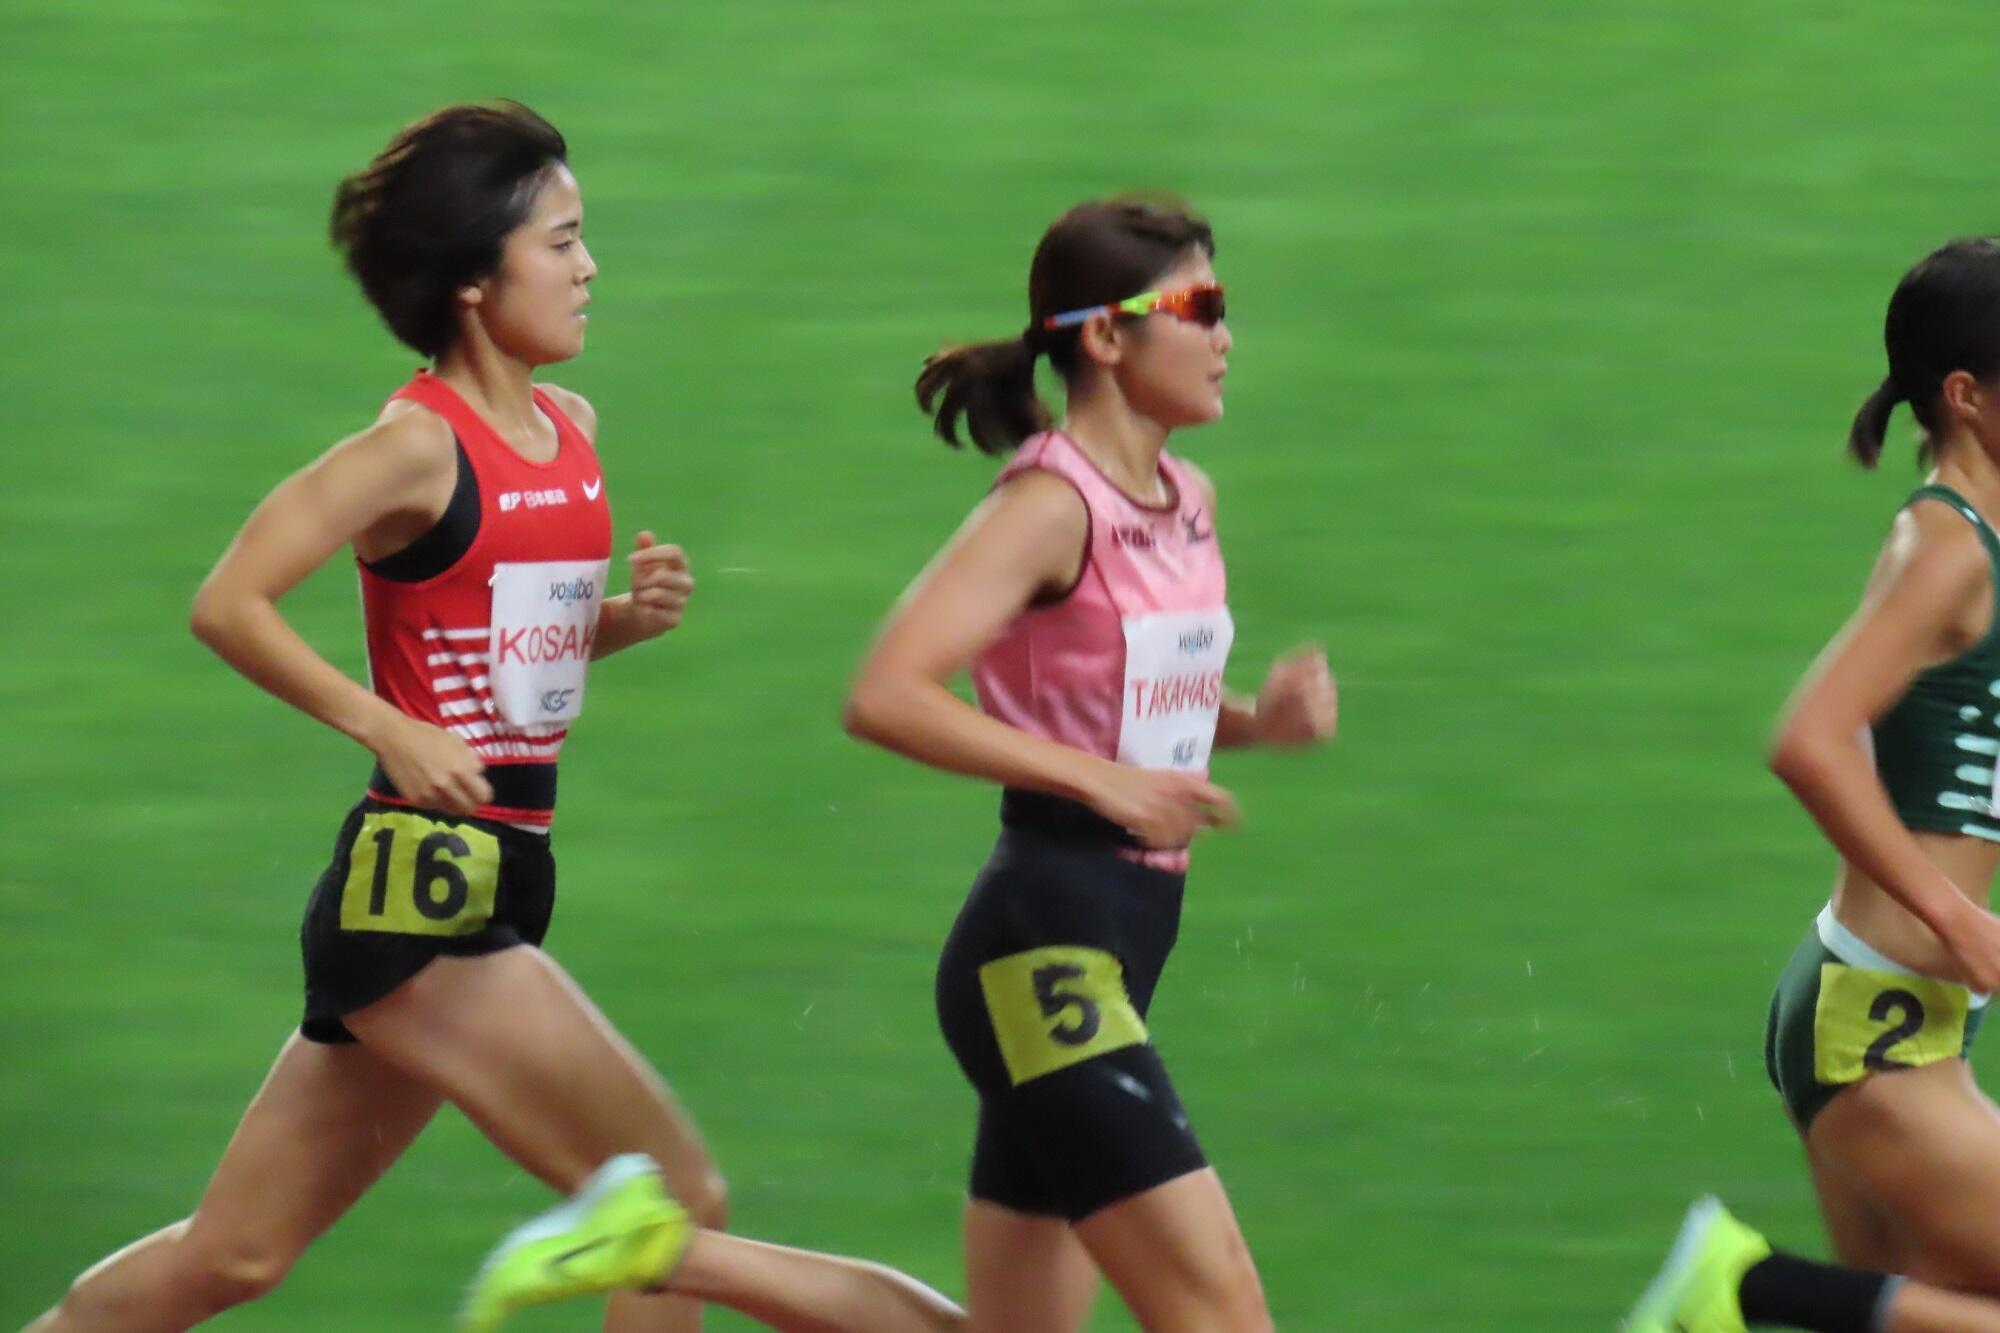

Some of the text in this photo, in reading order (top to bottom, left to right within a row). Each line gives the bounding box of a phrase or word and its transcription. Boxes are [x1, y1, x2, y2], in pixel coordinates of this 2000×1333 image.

[368, 827, 471, 921] 16
[1032, 963, 1100, 1046] 5
[1863, 987, 1925, 1071] 2
